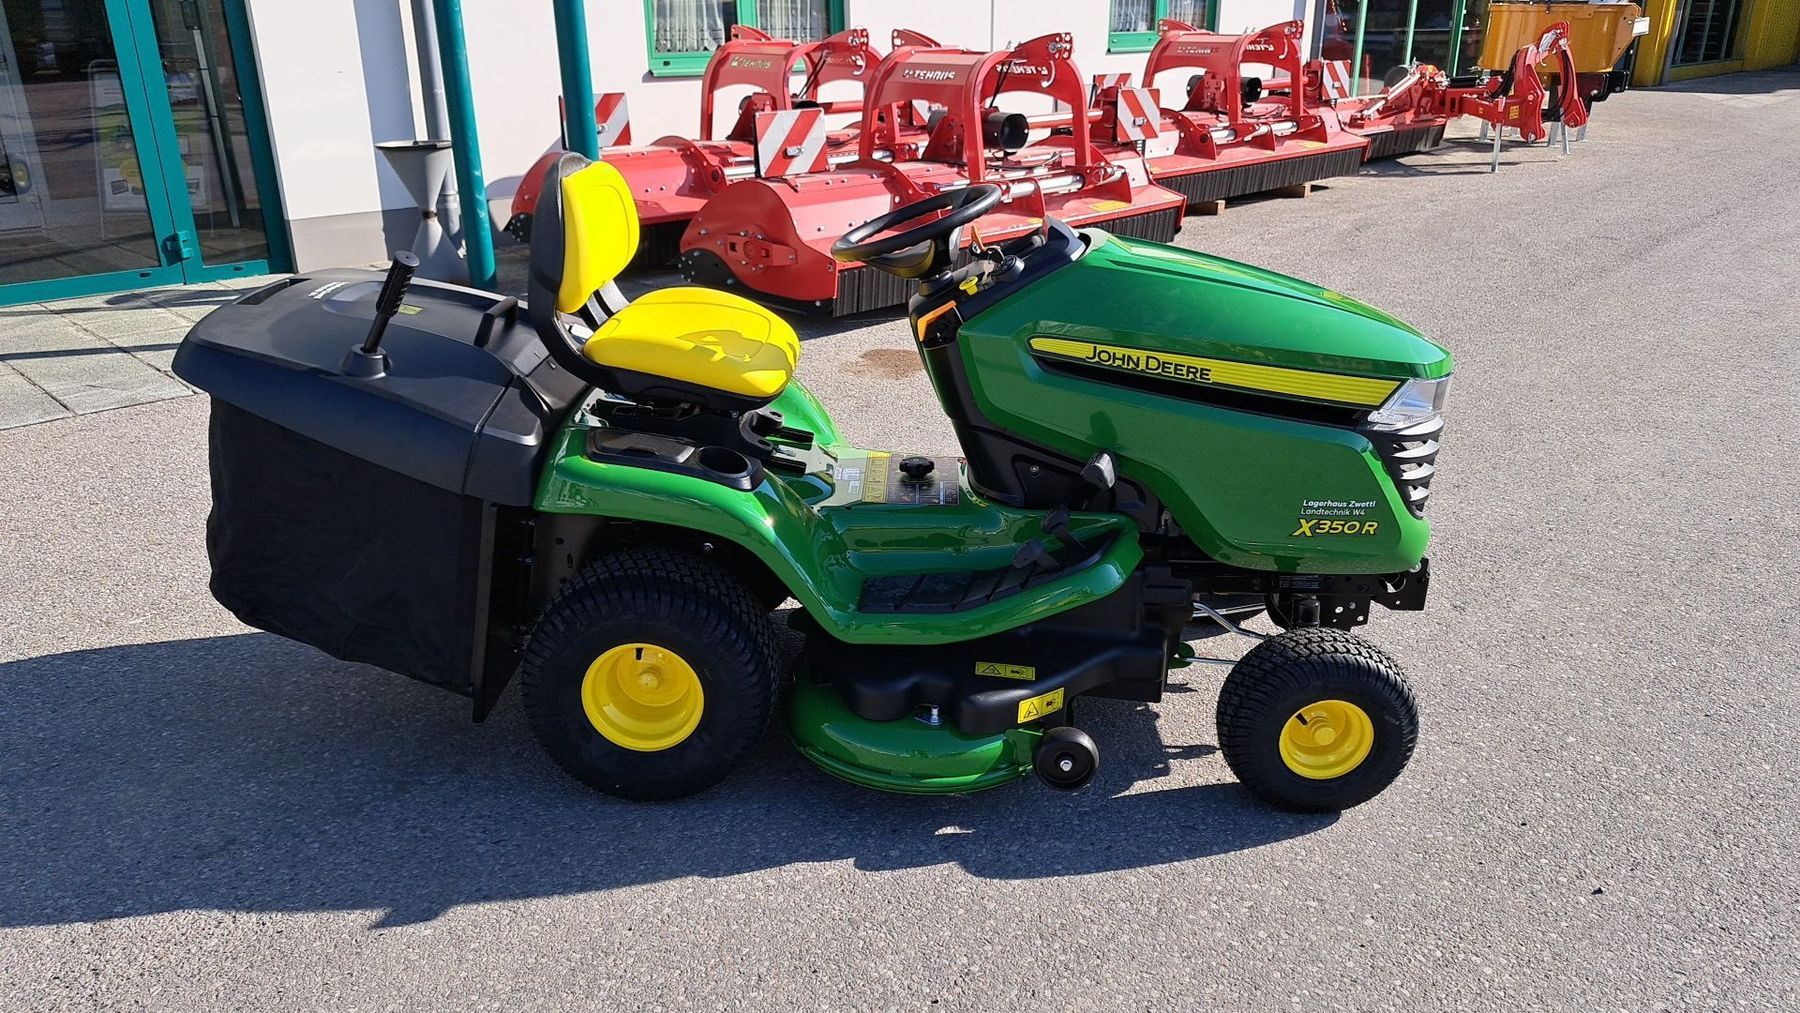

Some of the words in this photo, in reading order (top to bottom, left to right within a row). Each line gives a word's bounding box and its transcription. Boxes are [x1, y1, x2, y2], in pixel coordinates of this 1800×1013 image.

[1085, 345, 1140, 369] JOHN
[1145, 355, 1212, 382] DEERE
[1303, 499, 1347, 508] Lagerhaus
[1349, 500, 1376, 508] Zwettl
[1300, 507, 1350, 516] Landtechnik
[1352, 508, 1366, 516] W4
